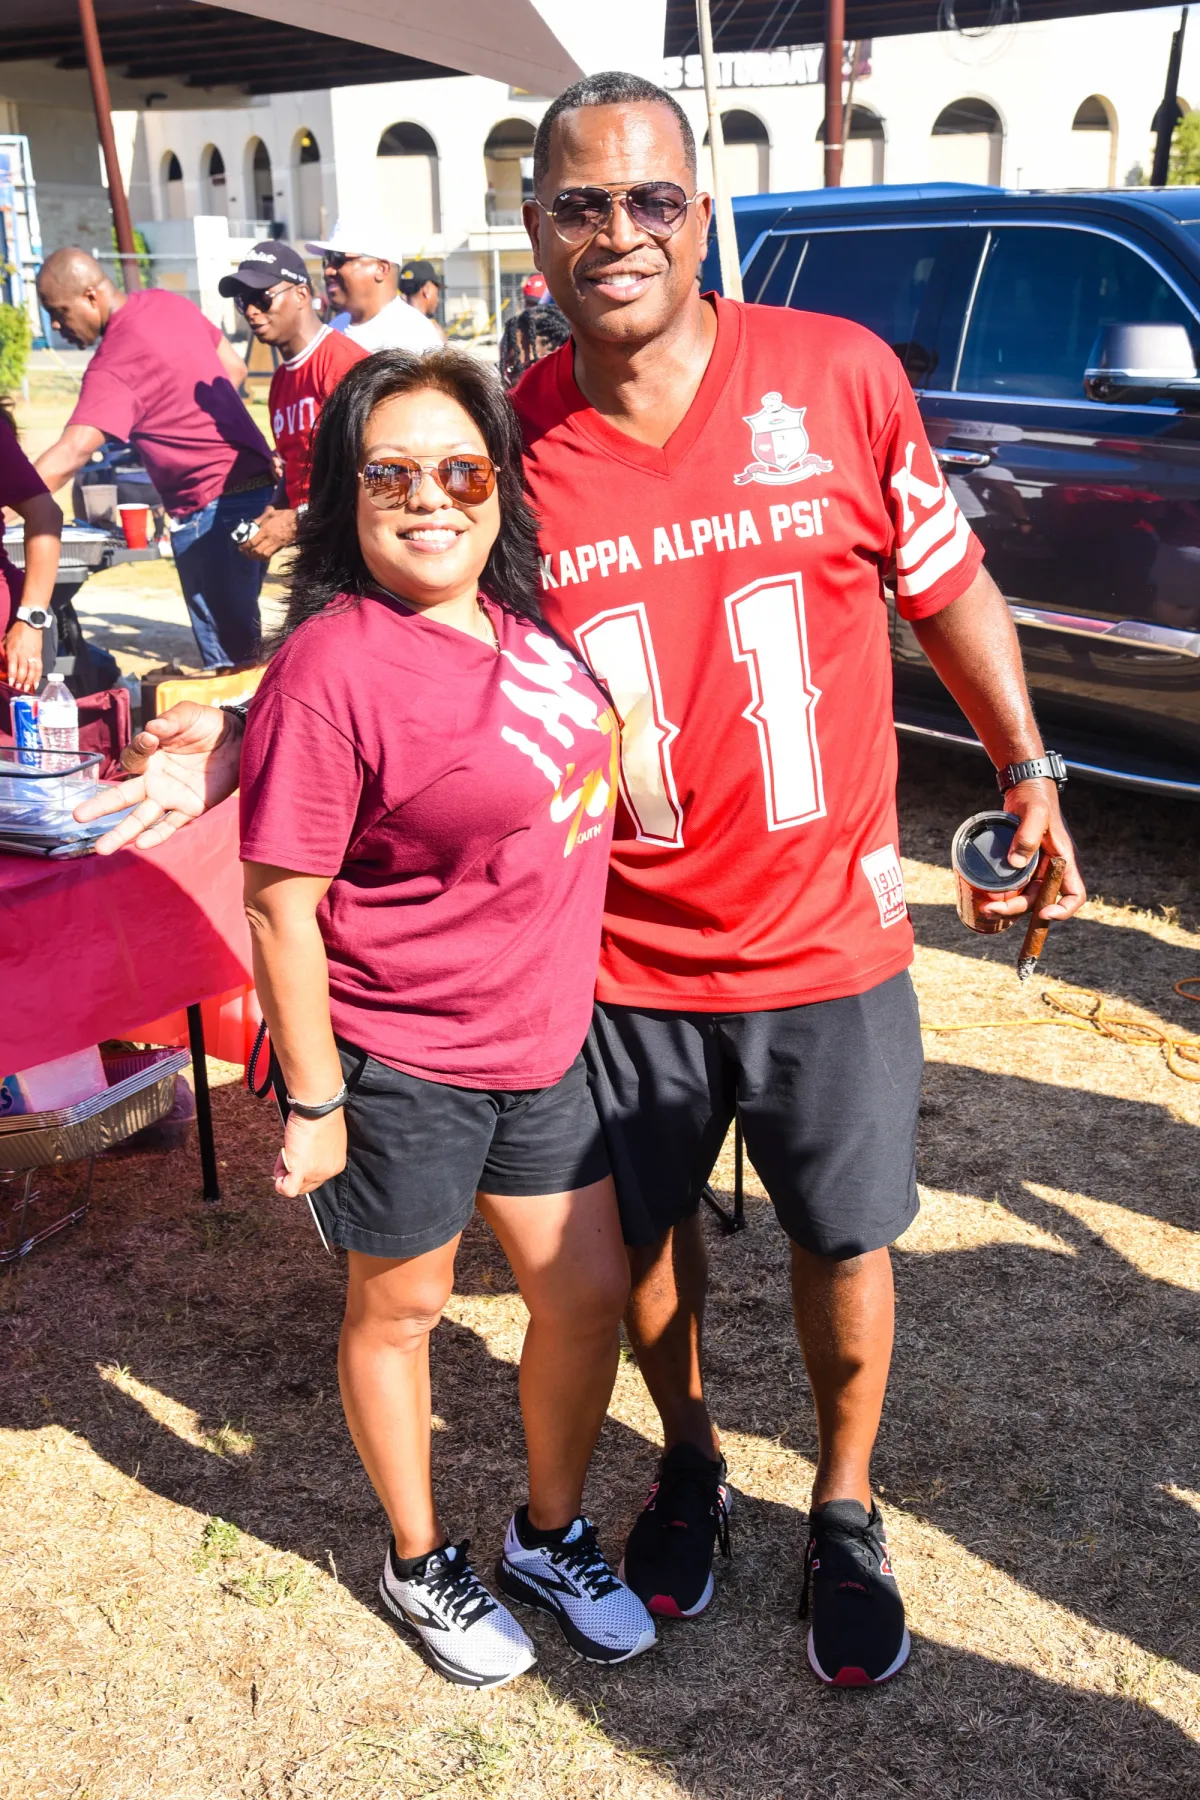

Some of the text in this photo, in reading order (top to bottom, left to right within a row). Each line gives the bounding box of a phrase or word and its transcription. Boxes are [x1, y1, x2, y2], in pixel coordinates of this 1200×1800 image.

[684, 48, 823, 87] STURDAY
[538, 535, 642, 591] KAPPA
[653, 509, 762, 566] ALPHA
[873, 865, 901, 894] 1911
